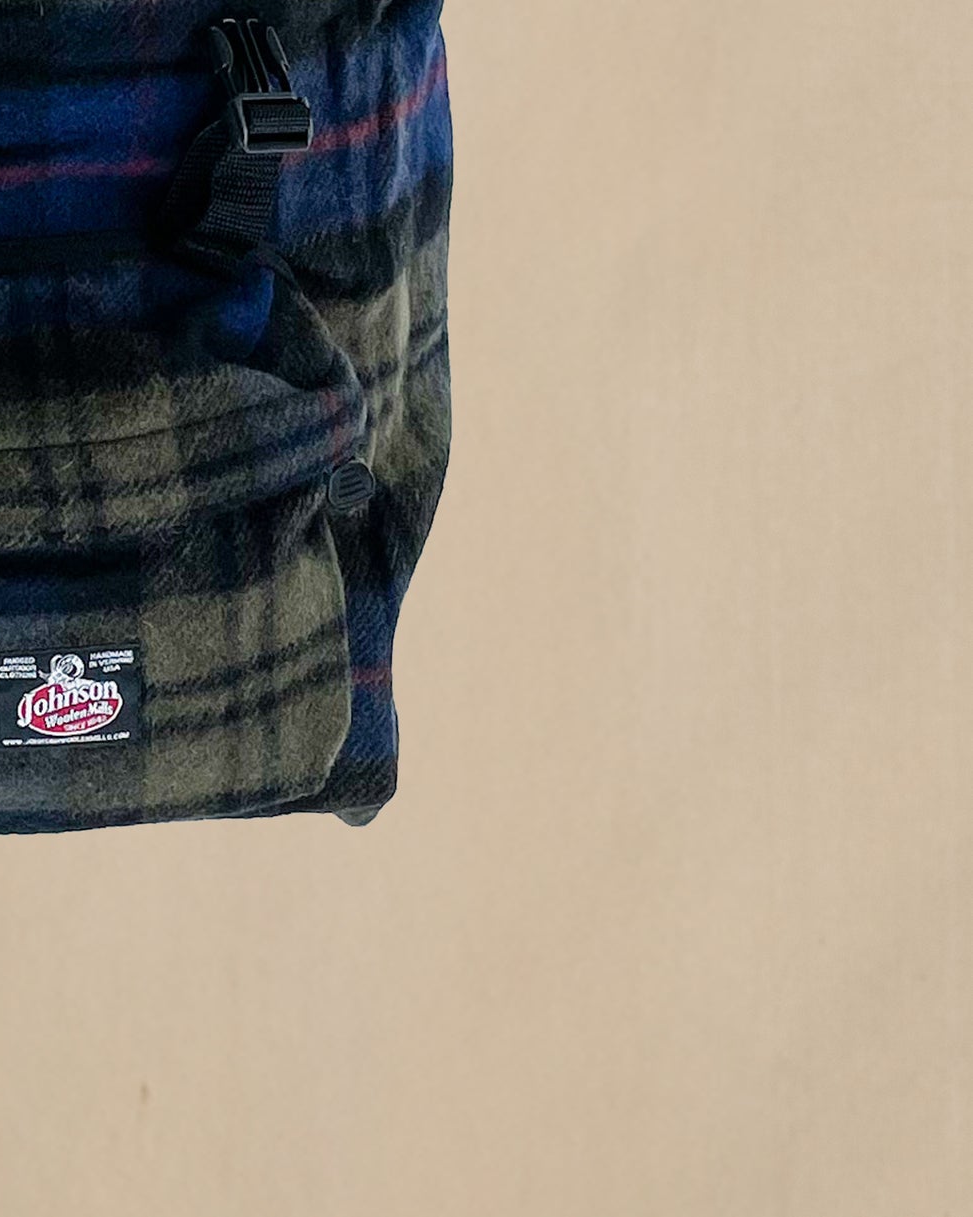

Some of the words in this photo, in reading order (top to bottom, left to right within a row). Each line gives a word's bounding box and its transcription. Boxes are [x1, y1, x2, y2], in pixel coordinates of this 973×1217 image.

[17, 680, 119, 727] Johnson
[44, 709, 87, 729] Woolen
[87, 701, 114, 717] Mills
